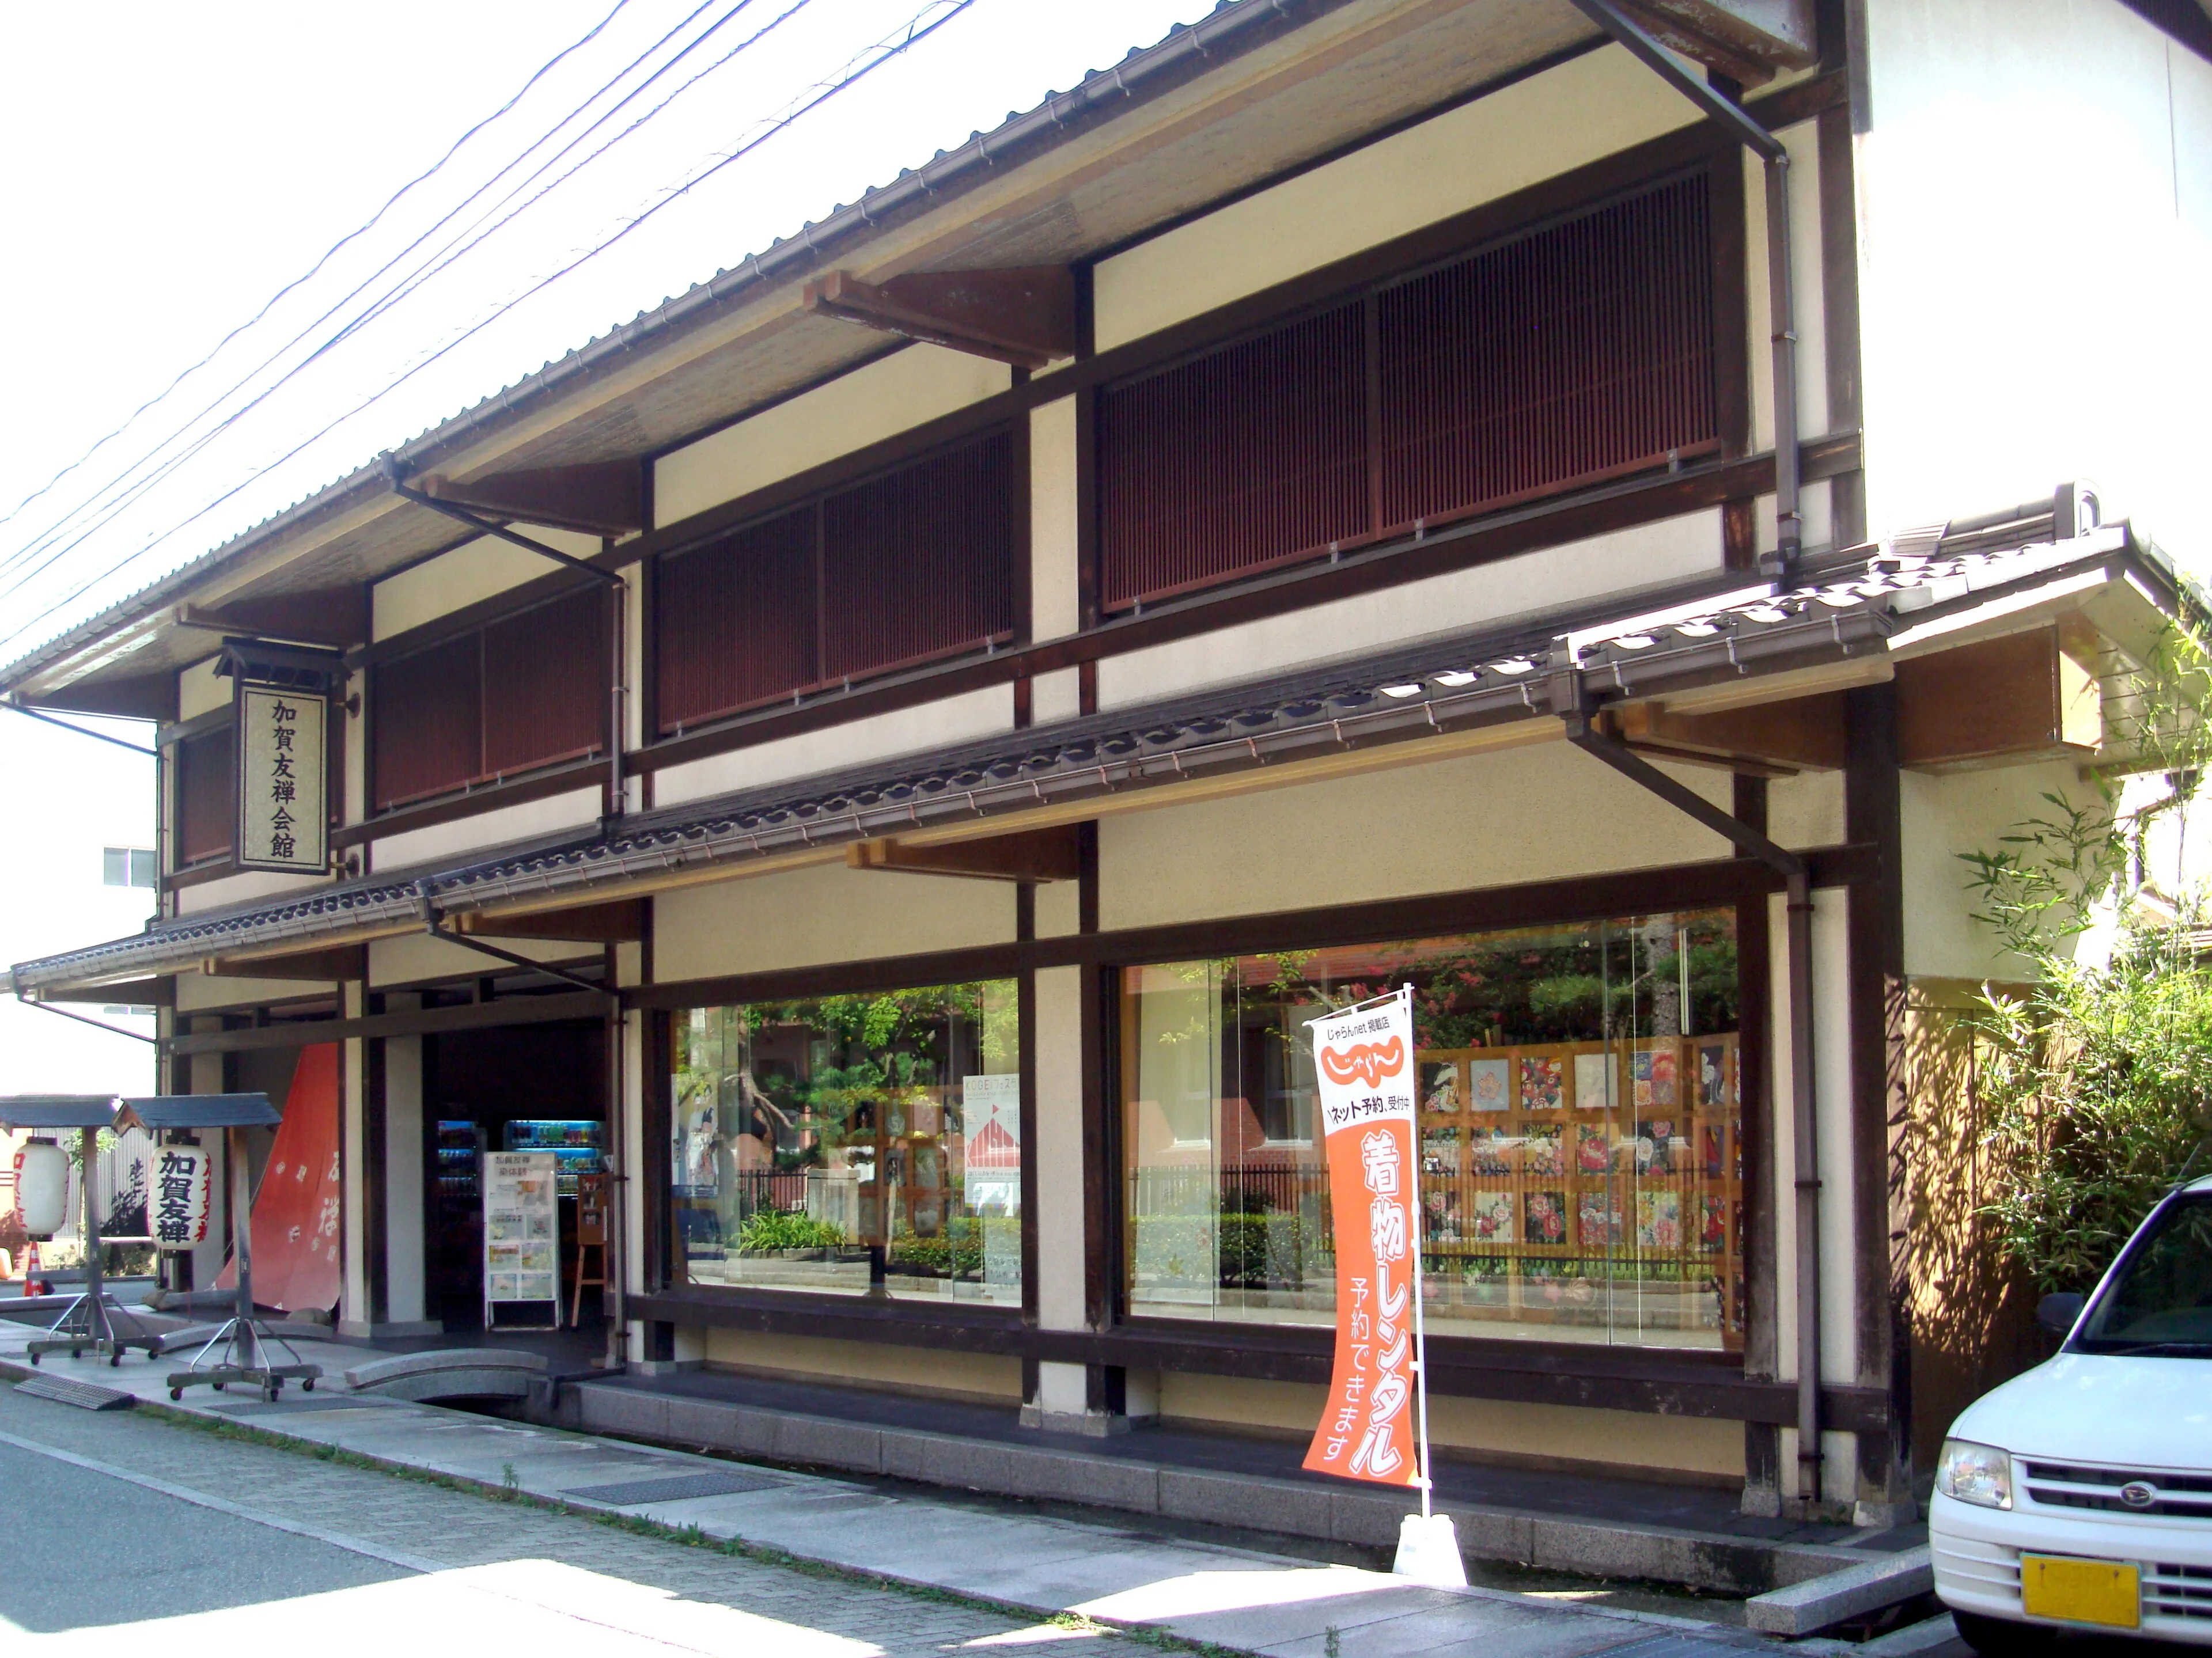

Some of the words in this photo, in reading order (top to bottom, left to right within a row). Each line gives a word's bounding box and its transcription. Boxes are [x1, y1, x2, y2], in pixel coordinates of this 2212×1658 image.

[270, 699, 297, 859] 加賀友禅会館
[1327, 1022, 1367, 1041] じゃらんnet
[1368, 1016, 1390, 1033] 掲載店
[1327, 1049, 1399, 1078] じゃらん
[156, 1151, 196, 1243] 加賀友禅
[1349, 1129, 1407, 1477] 着物レンタル
[1323, 1277, 1369, 1460] 予約できます
